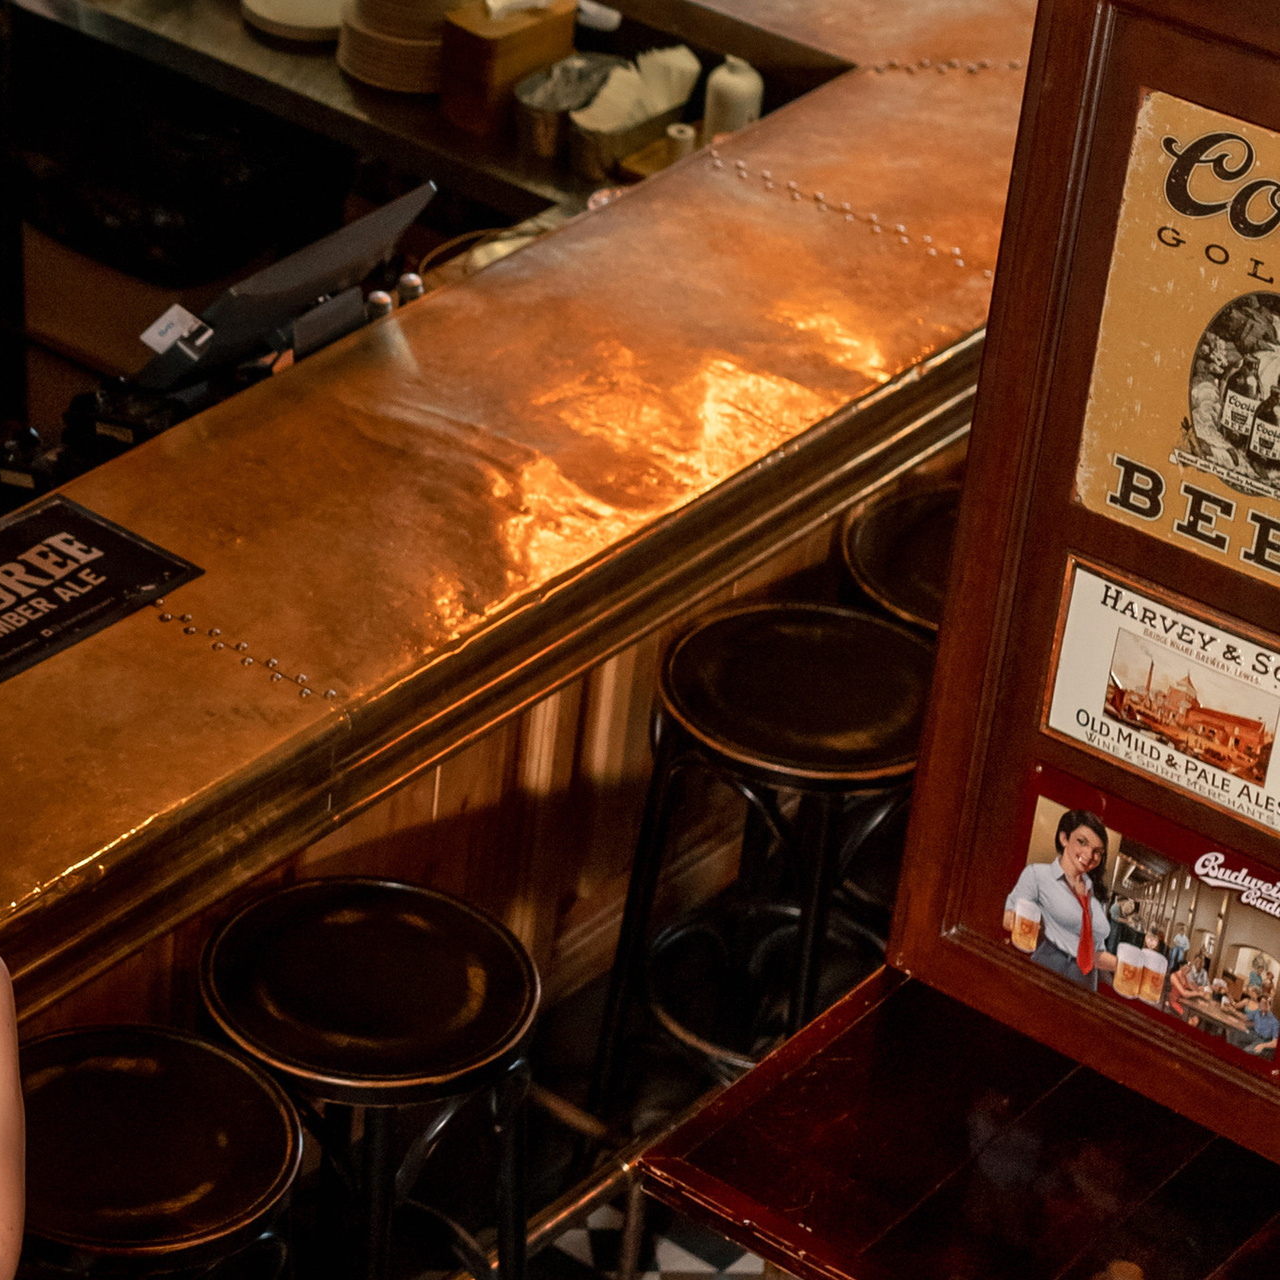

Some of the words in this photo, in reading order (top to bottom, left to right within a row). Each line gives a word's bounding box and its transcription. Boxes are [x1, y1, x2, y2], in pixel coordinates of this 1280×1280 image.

[1157, 226, 1274, 284] GOL
[53, 568, 107, 602] ALE
[1101, 584, 1218, 652] HARVEY
[1222, 644, 1241, 665] &
[1085, 730, 1119, 754] WINE
[1135, 756, 1182, 783] SPIRIT
[1117, 728, 1161, 761] MILD
[1165, 753, 1182, 769] &
[1185, 759, 1232, 793] PALE
